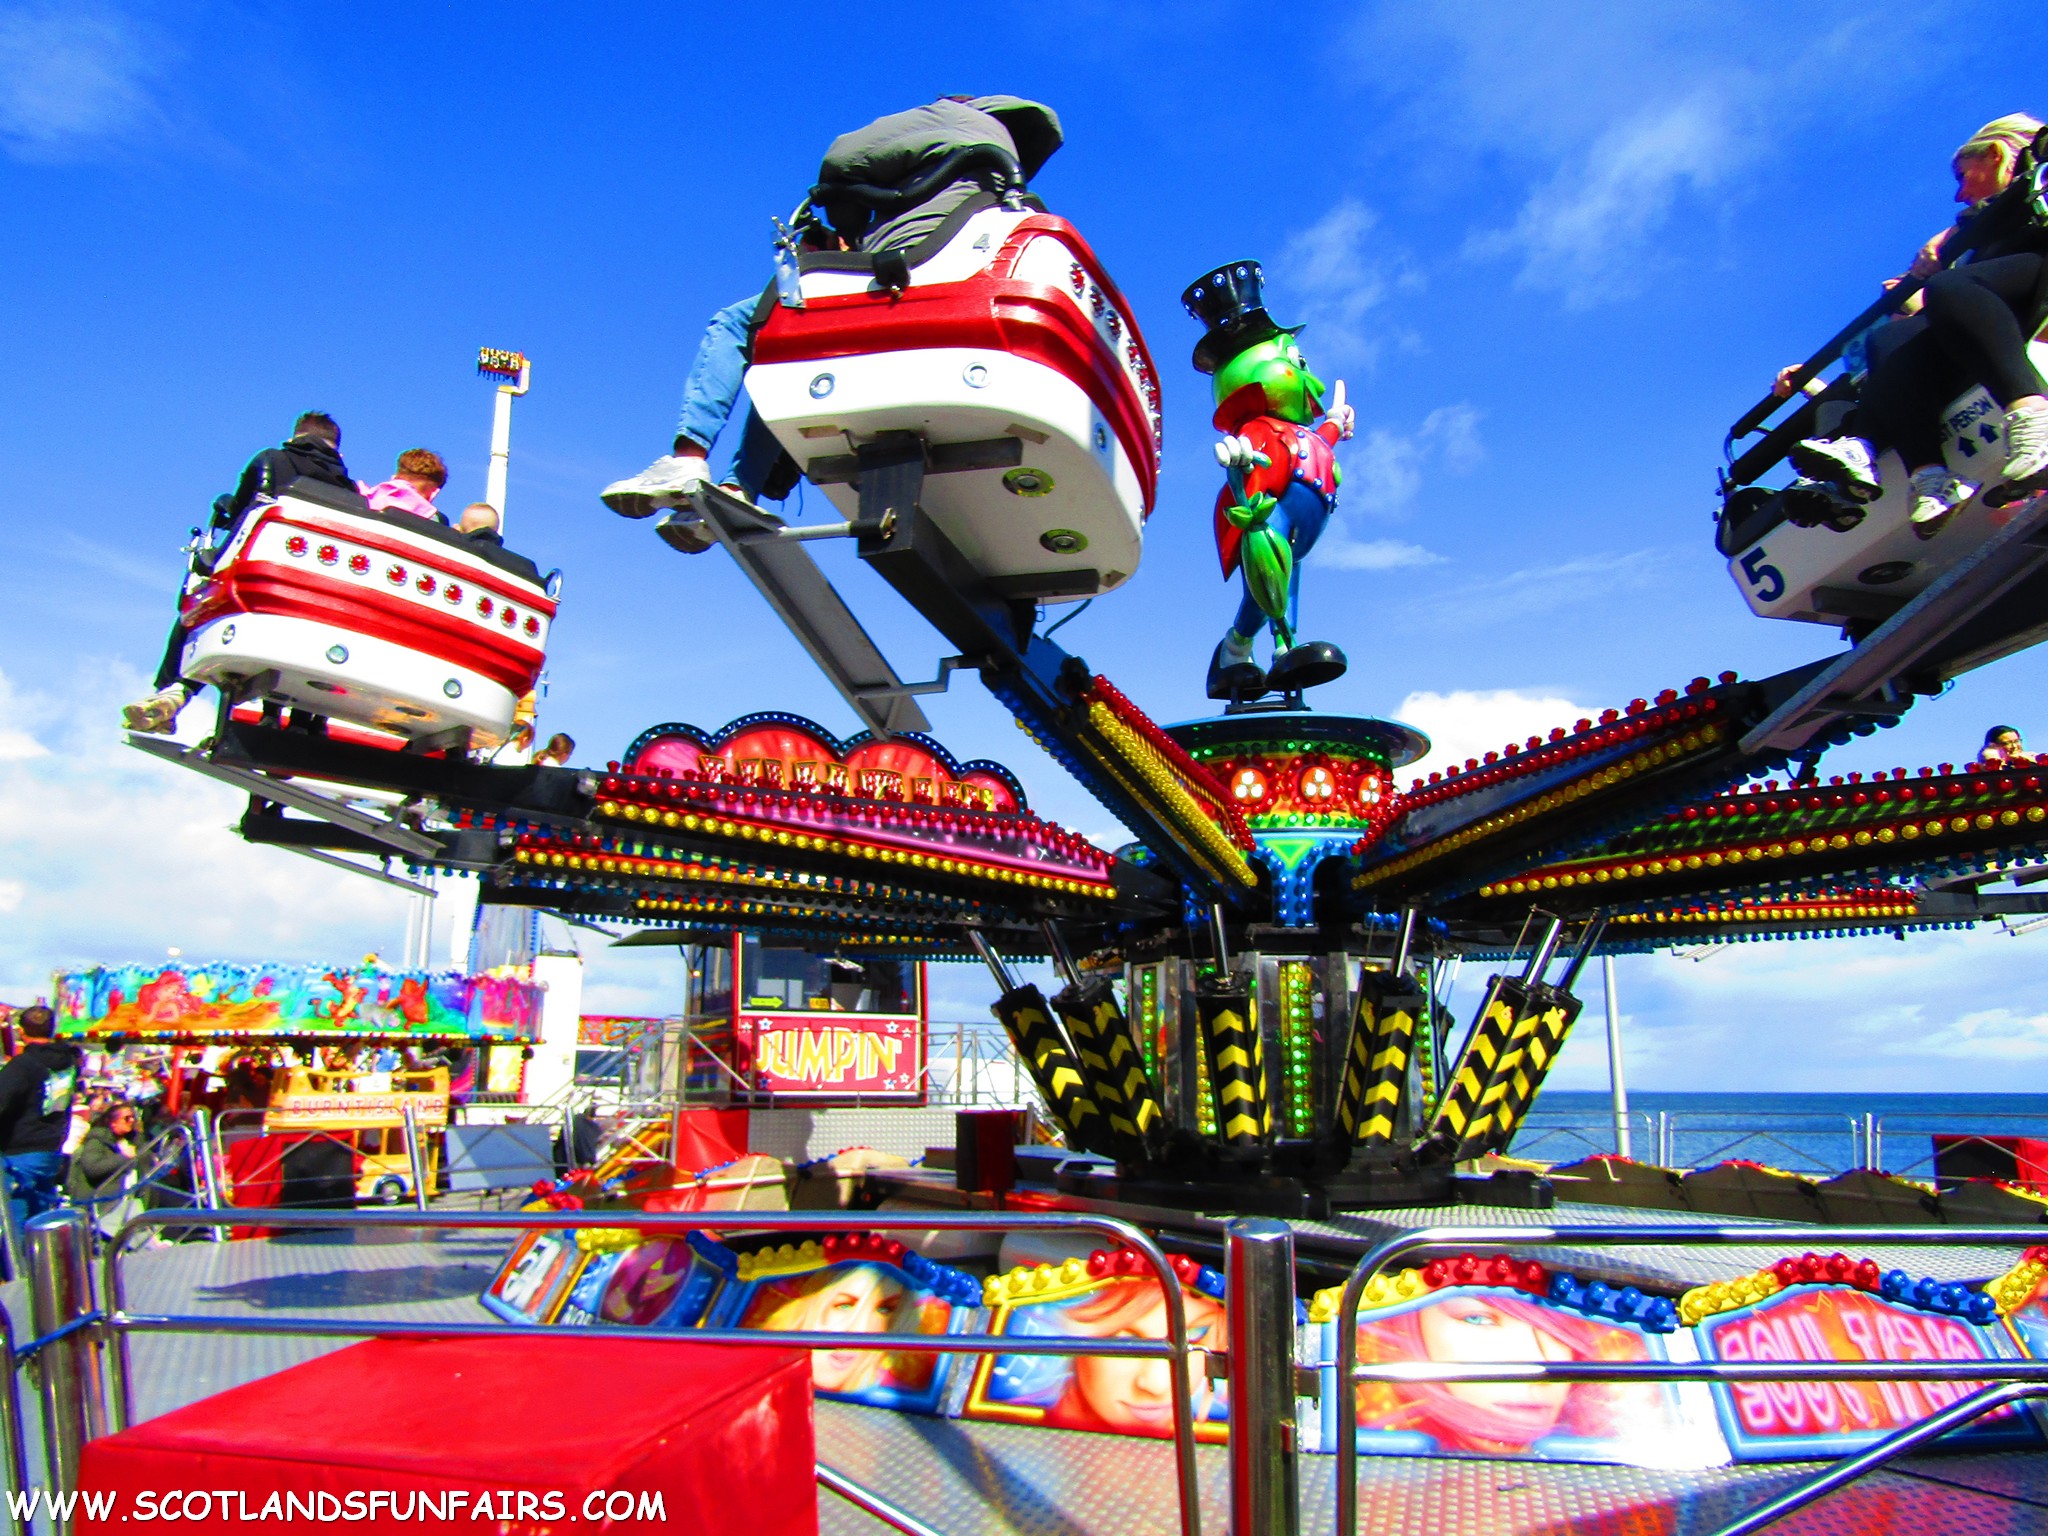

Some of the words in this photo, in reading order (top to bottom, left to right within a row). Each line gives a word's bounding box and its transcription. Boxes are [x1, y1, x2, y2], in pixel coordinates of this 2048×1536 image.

[973, 233, 990, 253] 4
[1948, 395, 1994, 432] PERSON
[1740, 546, 1784, 602] 5
[292, 1099, 444, 1116] BURNTISLAND
